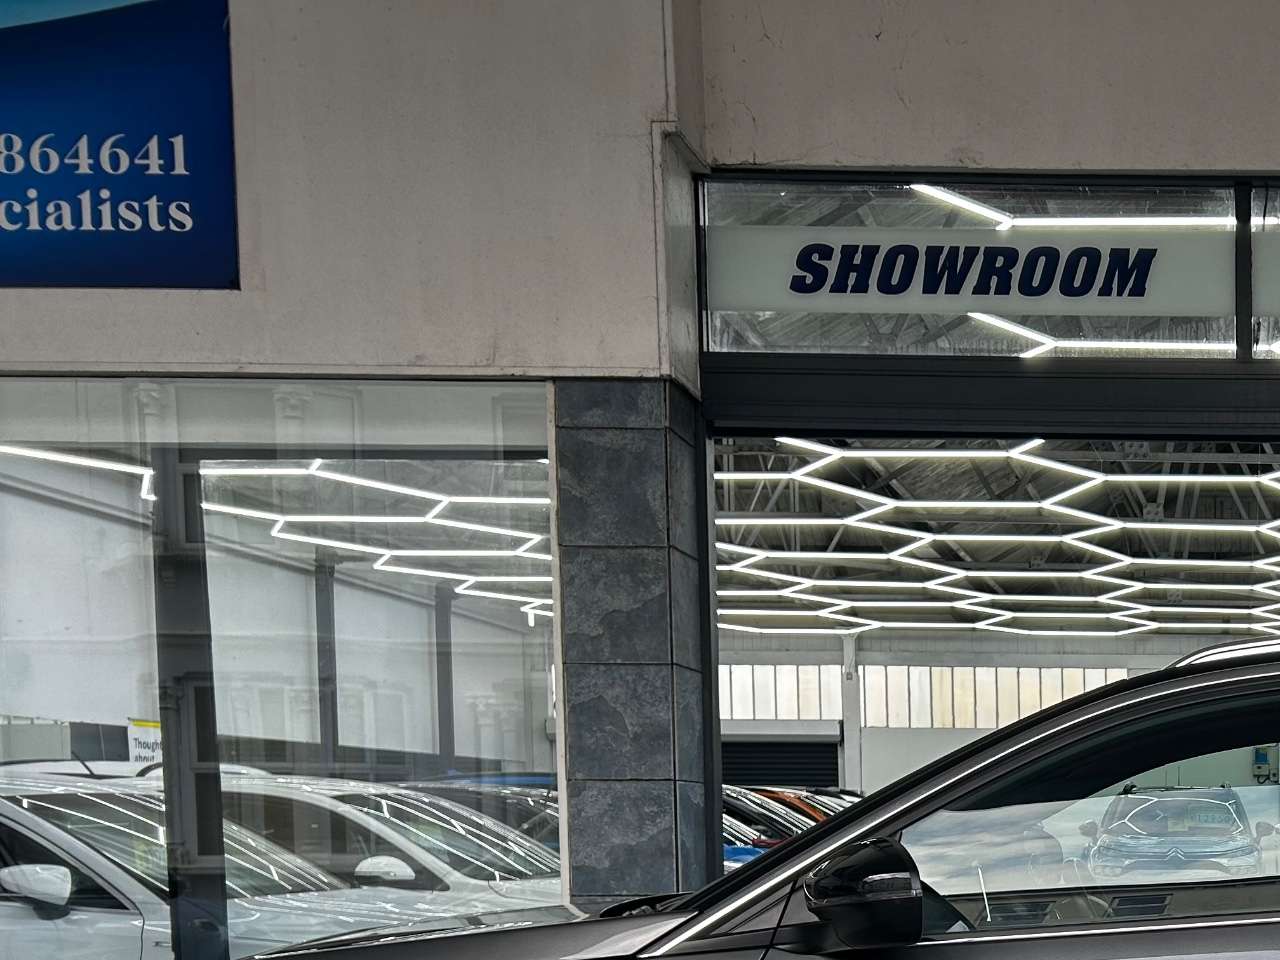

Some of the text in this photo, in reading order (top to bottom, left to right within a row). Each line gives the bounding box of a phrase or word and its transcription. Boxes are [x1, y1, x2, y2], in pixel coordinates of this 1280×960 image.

[0, 133, 190, 175] 864641
[0, 188, 193, 232] cialists
[790, 243, 1158, 297] SHOWROOM
